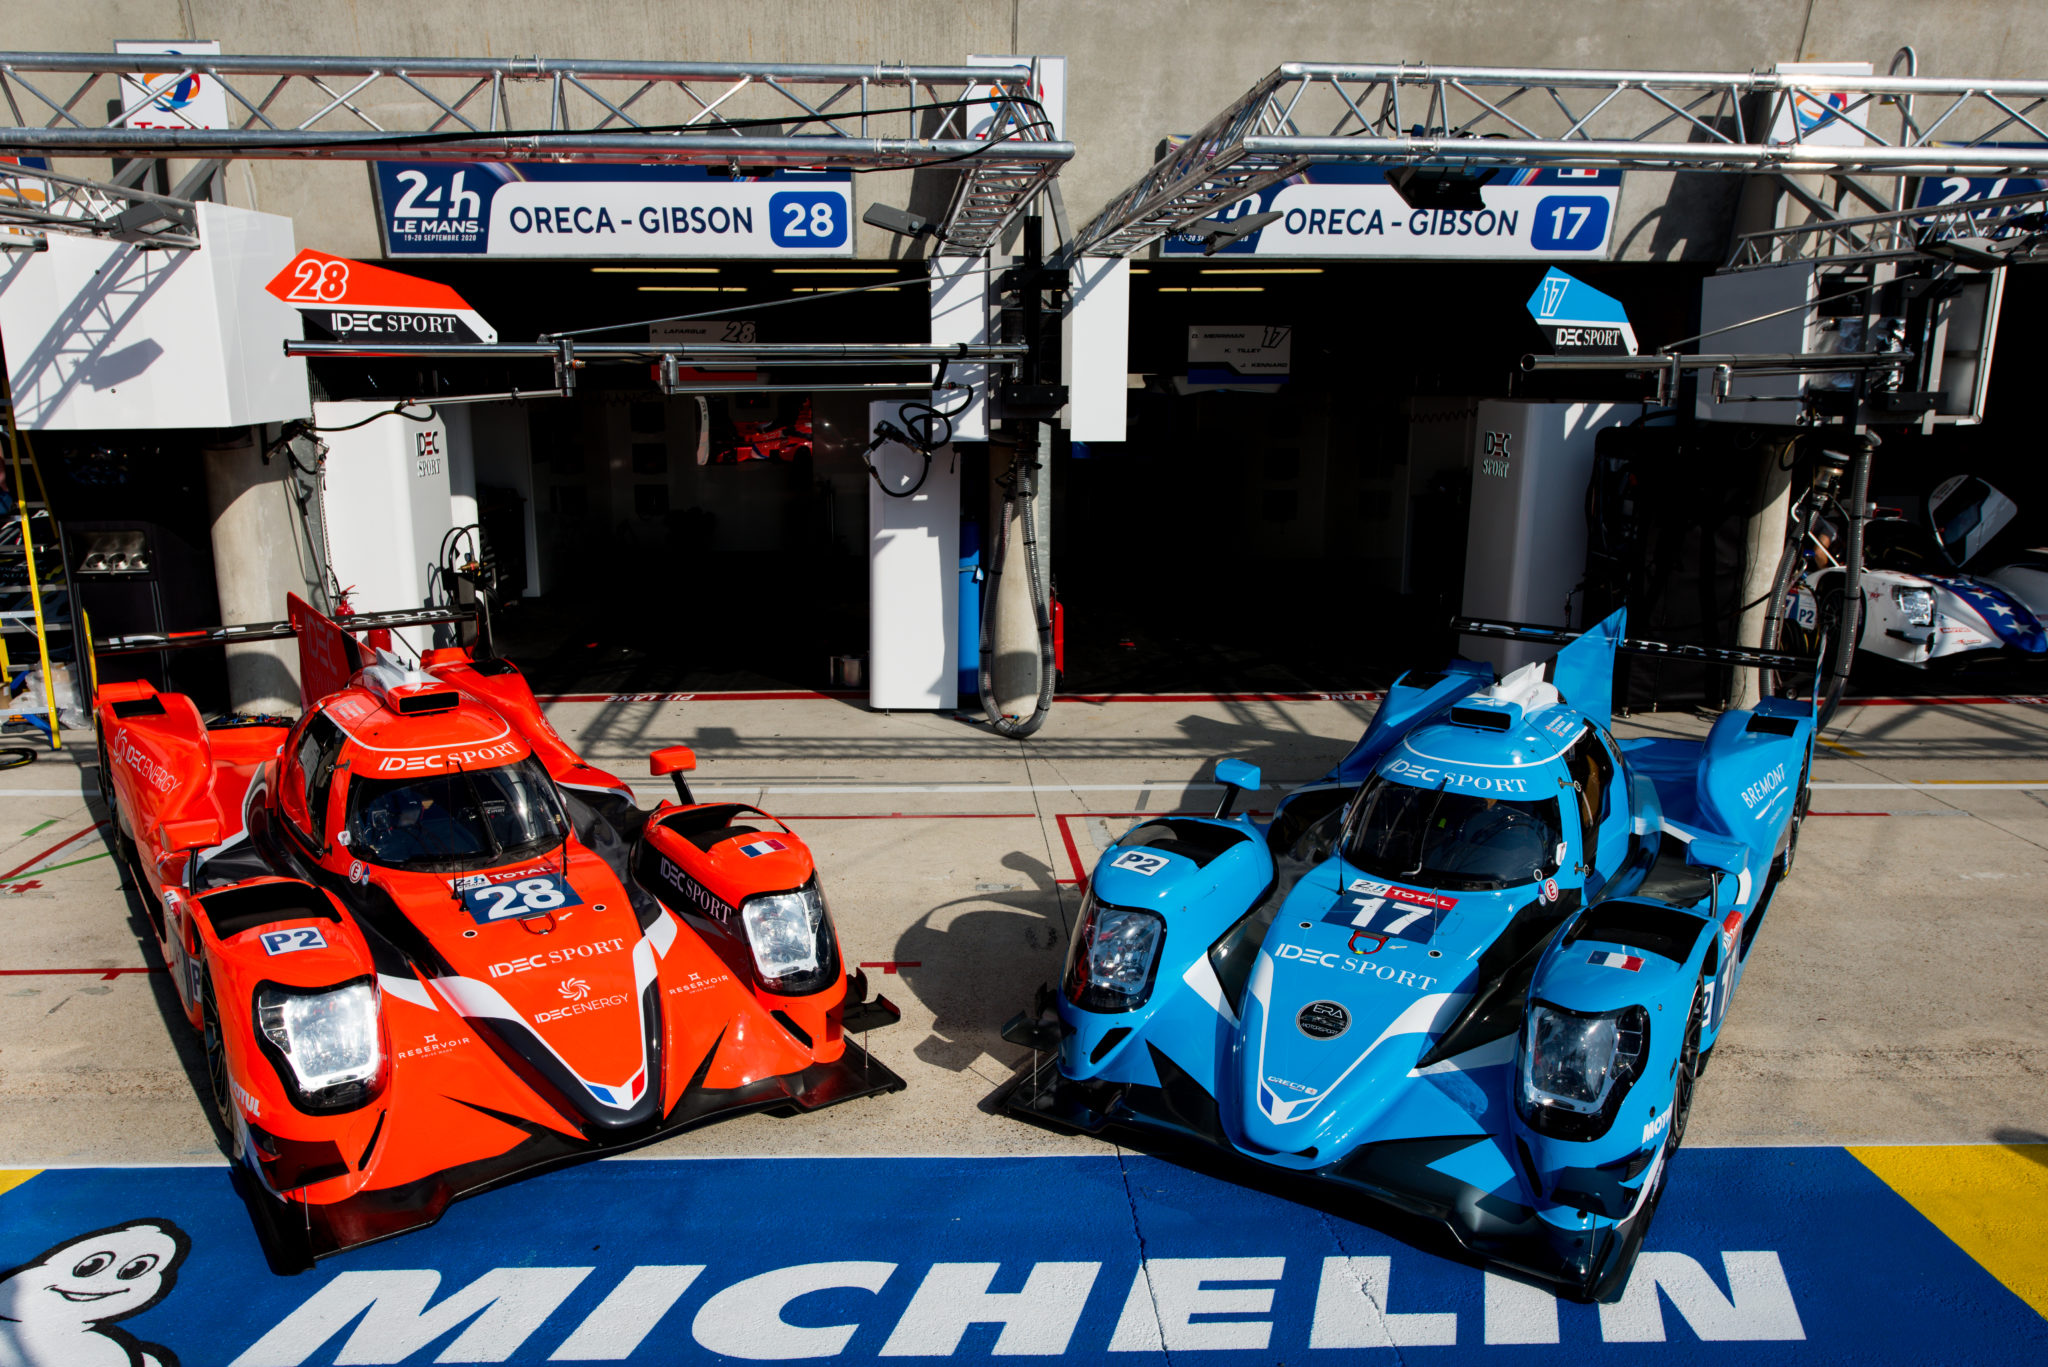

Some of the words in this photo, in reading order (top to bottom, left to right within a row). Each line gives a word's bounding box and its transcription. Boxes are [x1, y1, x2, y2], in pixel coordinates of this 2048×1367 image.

[394, 170, 481, 218] 24h
[393, 221, 418, 233] LE
[421, 221, 480, 233] MANS
[510, 206, 616, 234] ORECA
[638, 206, 753, 234] GIBSON
[782, 202, 835, 237] 28
[1285, 208, 1385, 235] ORECA
[1408, 208, 1519, 236] GIBSON
[1551, 206, 1592, 240] 17
[424, 234, 460, 242] SEPTEMBRE
[461, 234, 477, 242] 2020
[286, 259, 349, 302] 28
[1540, 277, 1570, 317] 17
[331, 313, 383, 332] IDEC
[387, 315, 457, 333] SPORT
[720, 320, 756, 343] 28
[1556, 328, 1583, 346] IDEC
[1583, 329, 1621, 346] SPORT
[416, 431, 440, 457] IDEC
[1484, 431, 1511, 458] IDEC
[417, 459, 440, 477] SPORT
[1482, 459, 1510, 478] SPORT
[1799, 609, 1815, 623] P2
[378, 755, 444, 771] IDEC
[447, 741, 520, 766] SPORT
[1385, 758, 1440, 782] IDEC
[1443, 771, 1528, 793] SPORT
[1741, 763, 1785, 809] BREMONT
[489, 866, 553, 880] TOTAL
[1116, 853, 1161, 872] P2
[474, 878, 566, 920] 28
[661, 856, 686, 893] IDEC
[685, 878, 732, 925] SPORT
[1391, 887, 1452, 908] TOTAL
[1350, 897, 1433, 935] 17
[264, 930, 324, 952] P2
[488, 954, 547, 978] IDEC
[548, 938, 625, 964] SPORT
[1274, 943, 1340, 969] IDEC
[1341, 957, 1437, 991] SPORT
[668, 974, 729, 995] RESERVOIR
[1313, 1004, 1343, 1019] ERA
[398, 1037, 470, 1060] RESERVOIR
[228, 1250, 1808, 1367] MICHELIN
